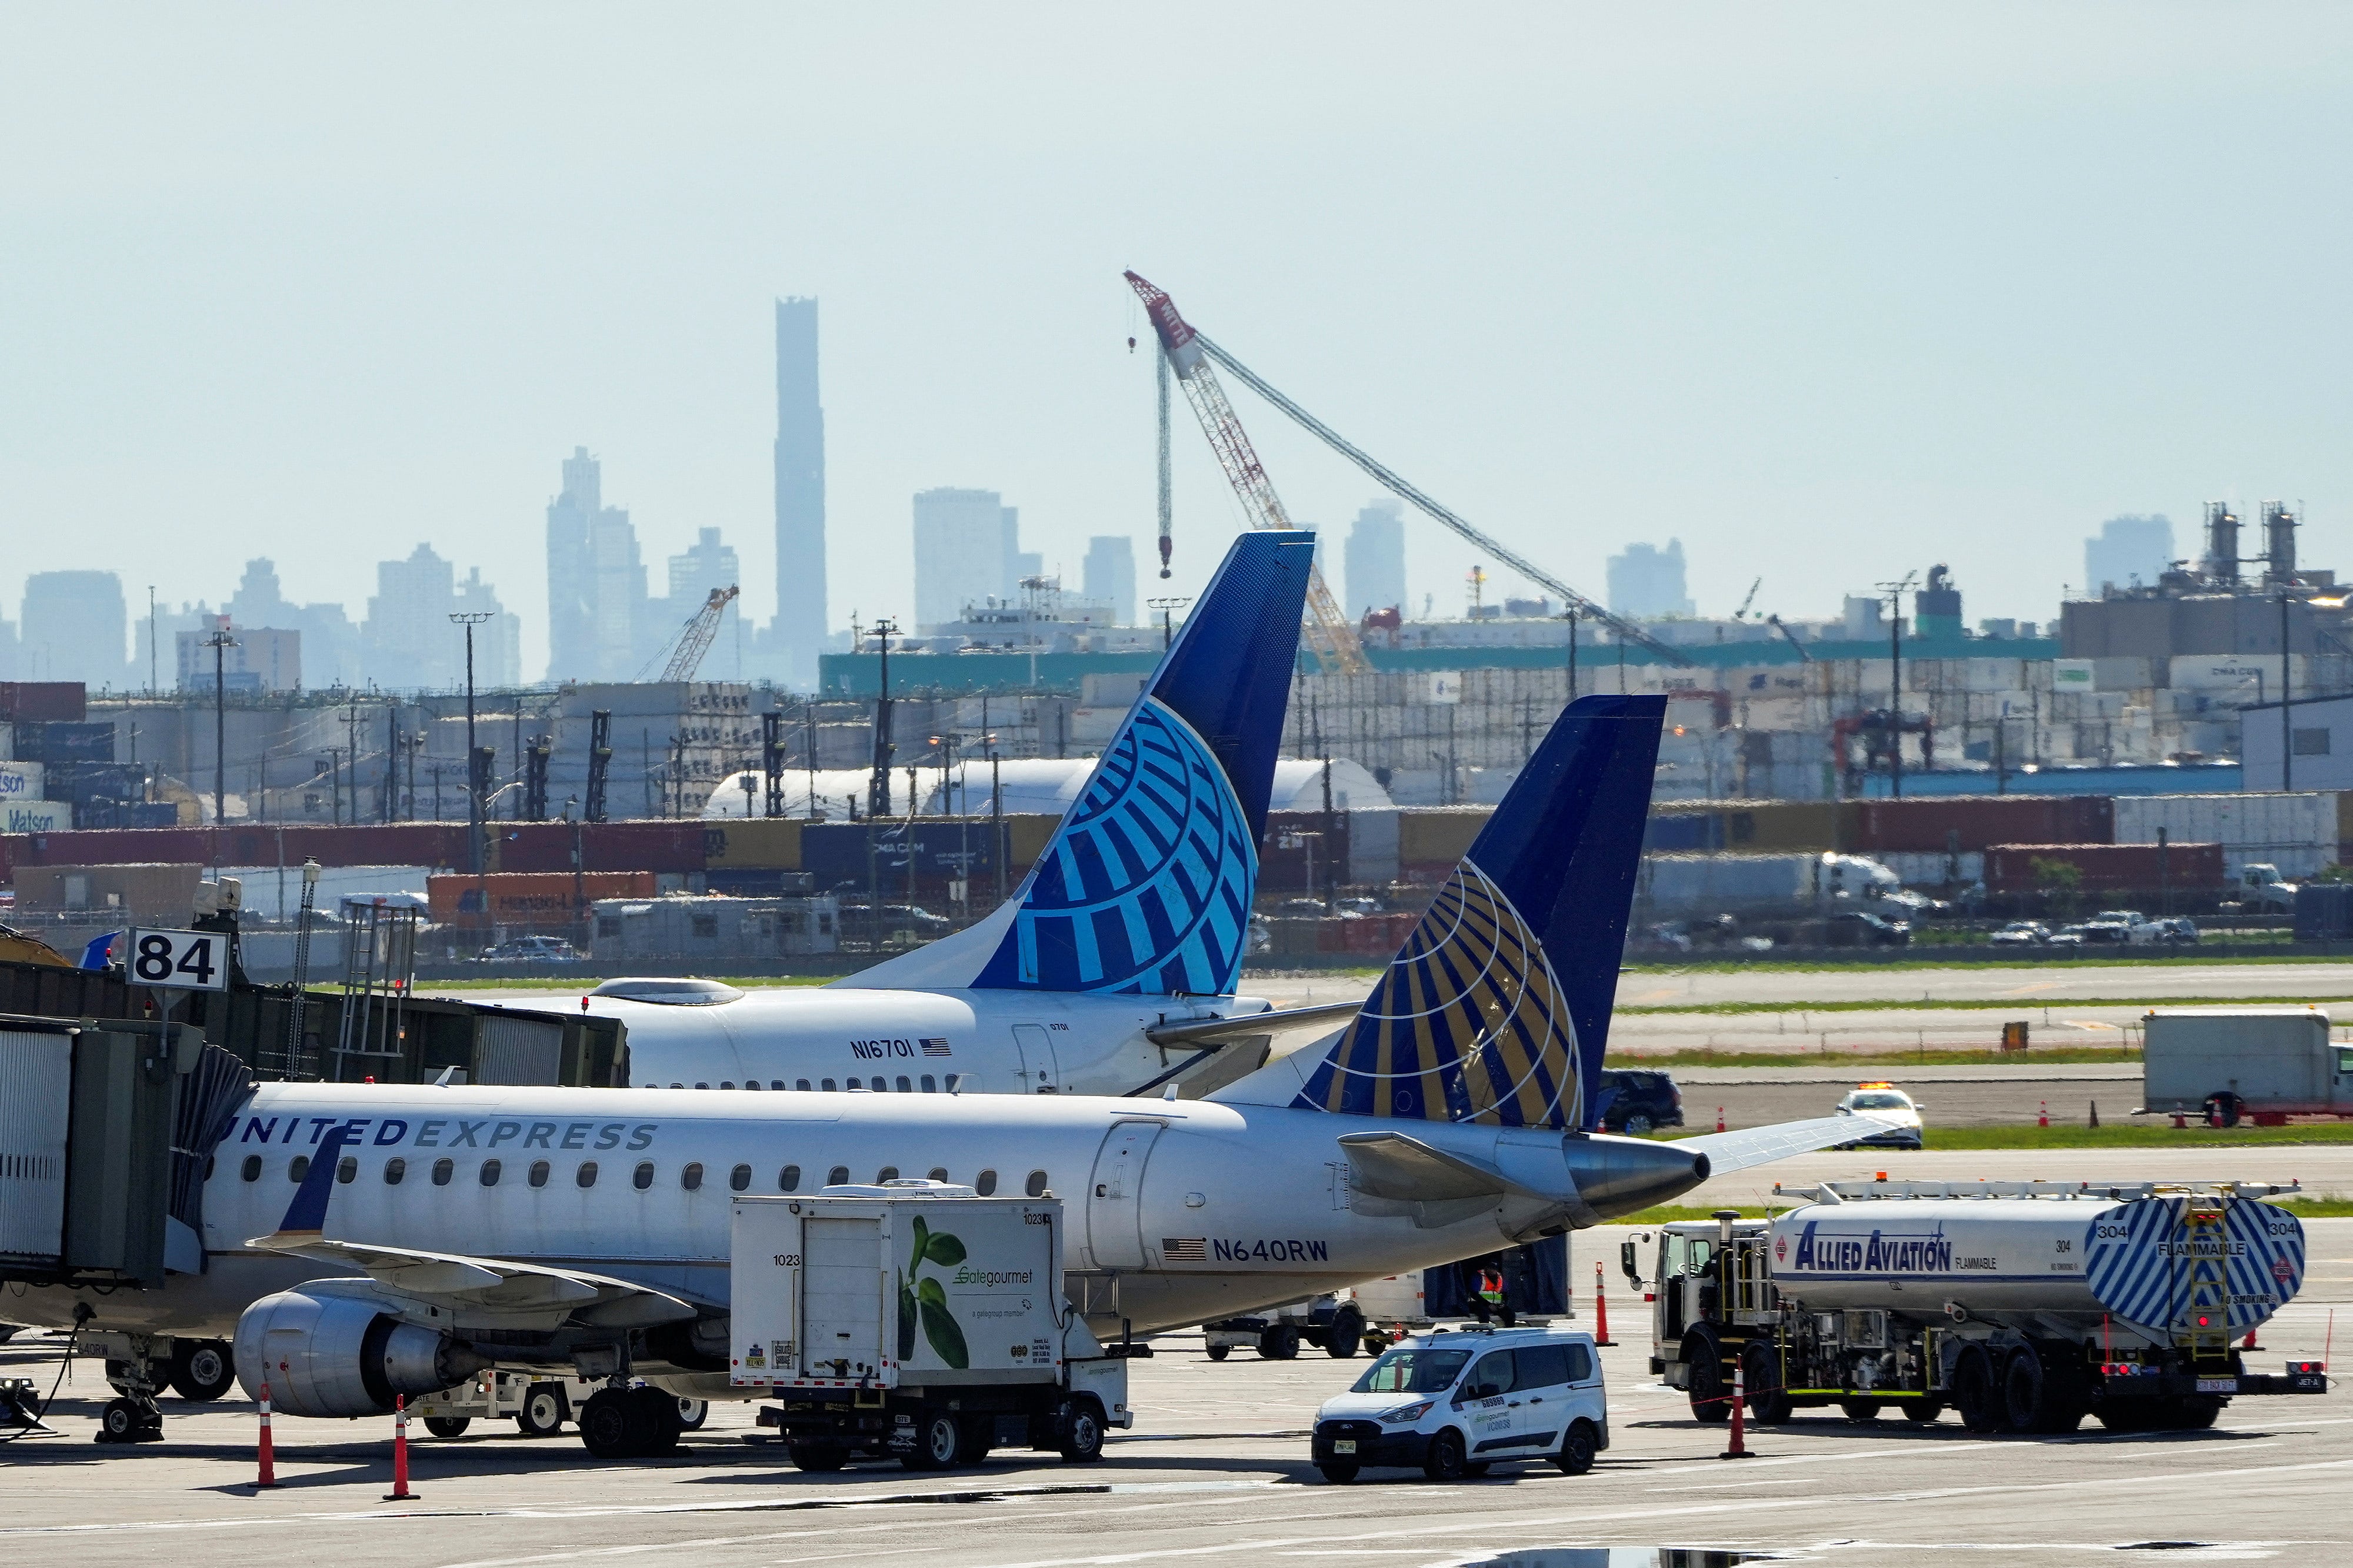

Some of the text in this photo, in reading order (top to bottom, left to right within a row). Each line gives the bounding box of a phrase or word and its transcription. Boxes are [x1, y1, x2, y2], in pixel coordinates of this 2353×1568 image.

[135, 935, 215, 984] 84
[849, 1039, 915, 1059] N16701
[414, 1120, 658, 1151] EXPRESS
[1024, 1213, 1042, 1225] 1023
[2097, 1226, 2128, 1239] 304
[2270, 1223, 2296, 1236] 304
[1213, 1239, 1328, 1262] N640RW
[1795, 1221, 1952, 1272] ALLIED AVIATION
[2056, 1240, 2070, 1253] 304
[773, 1255, 800, 1266] 1023
[1955, 1257, 1997, 1270] FLAMMABLE
[2233, 1294, 2270, 1304] SMOKING
